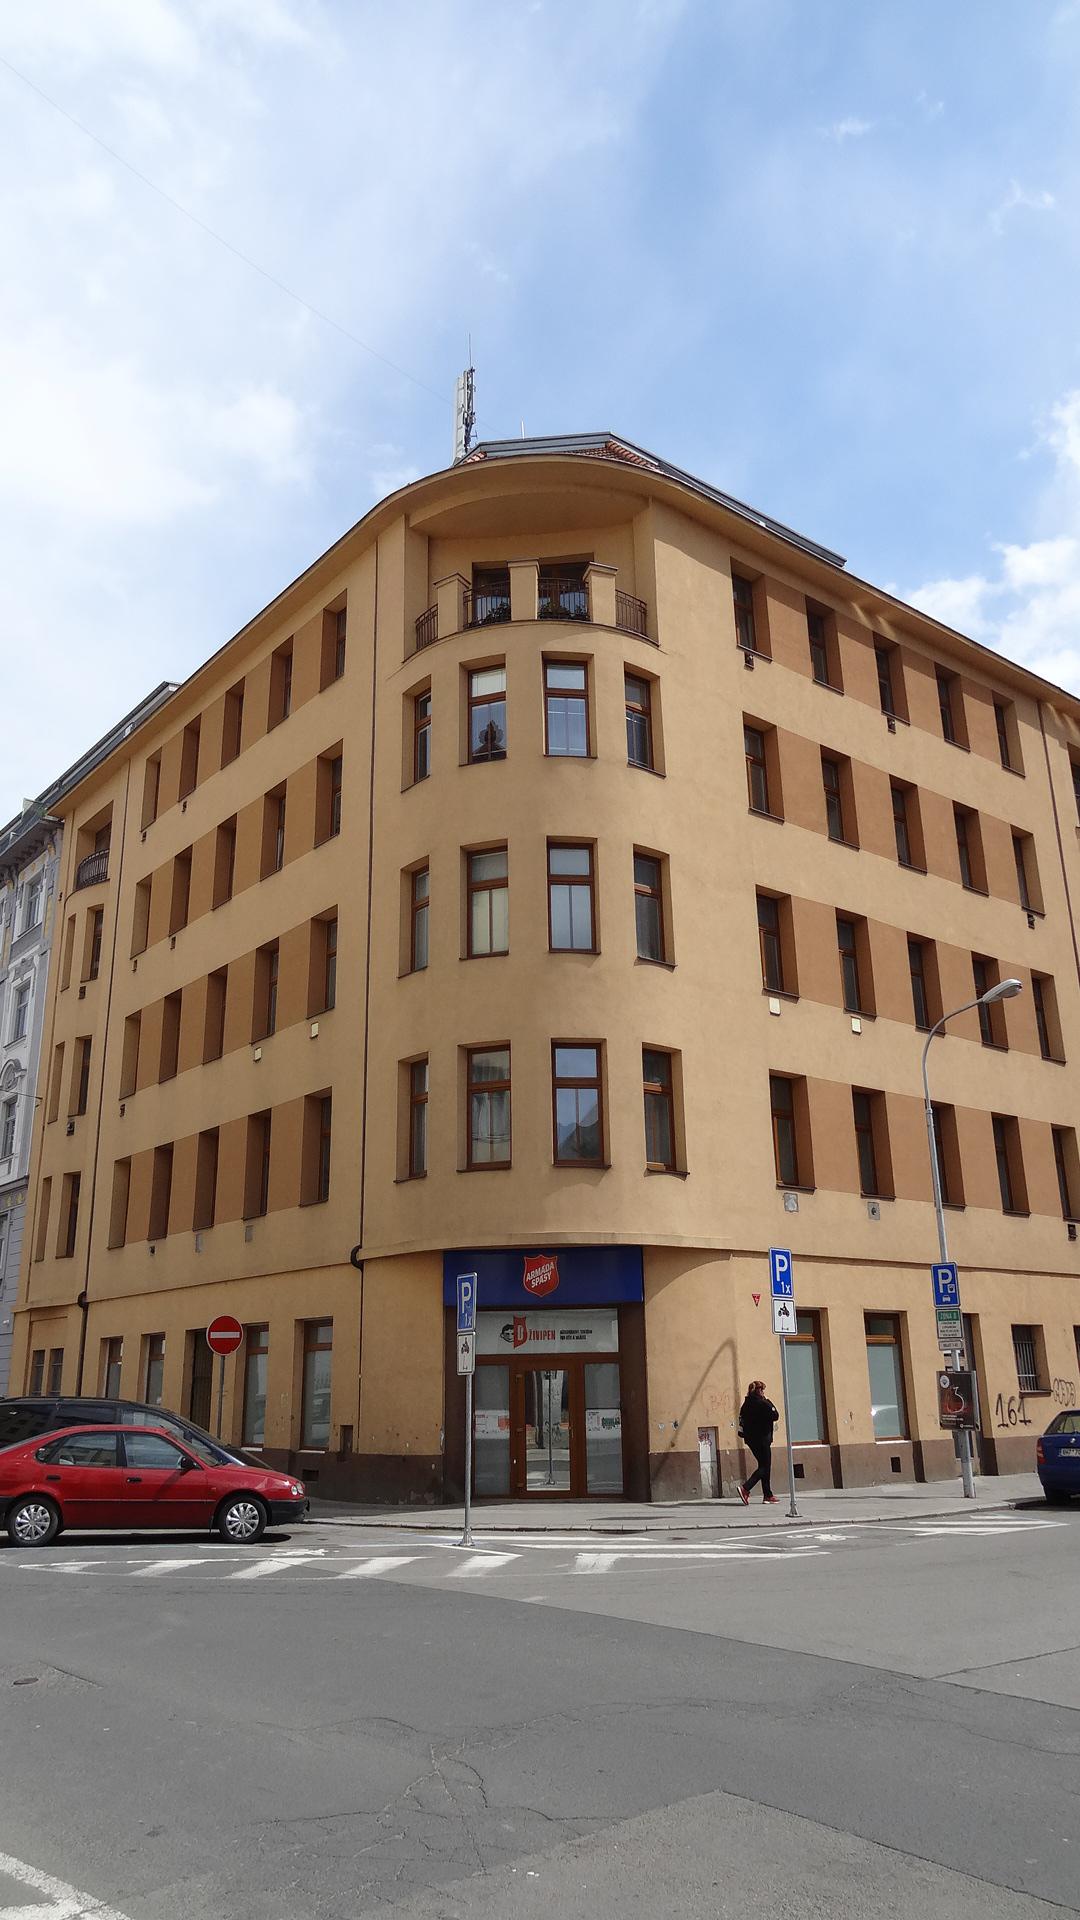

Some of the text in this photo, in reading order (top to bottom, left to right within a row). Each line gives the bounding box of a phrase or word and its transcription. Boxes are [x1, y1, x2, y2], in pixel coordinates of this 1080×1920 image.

[775, 1254, 789, 1281] P
[938, 1268, 952, 1293] P
[461, 1282, 472, 1313] P
[781, 1281, 791, 1294] 1x
[465, 1313, 472, 1327] 1x
[996, 1393, 1032, 1428] 161
